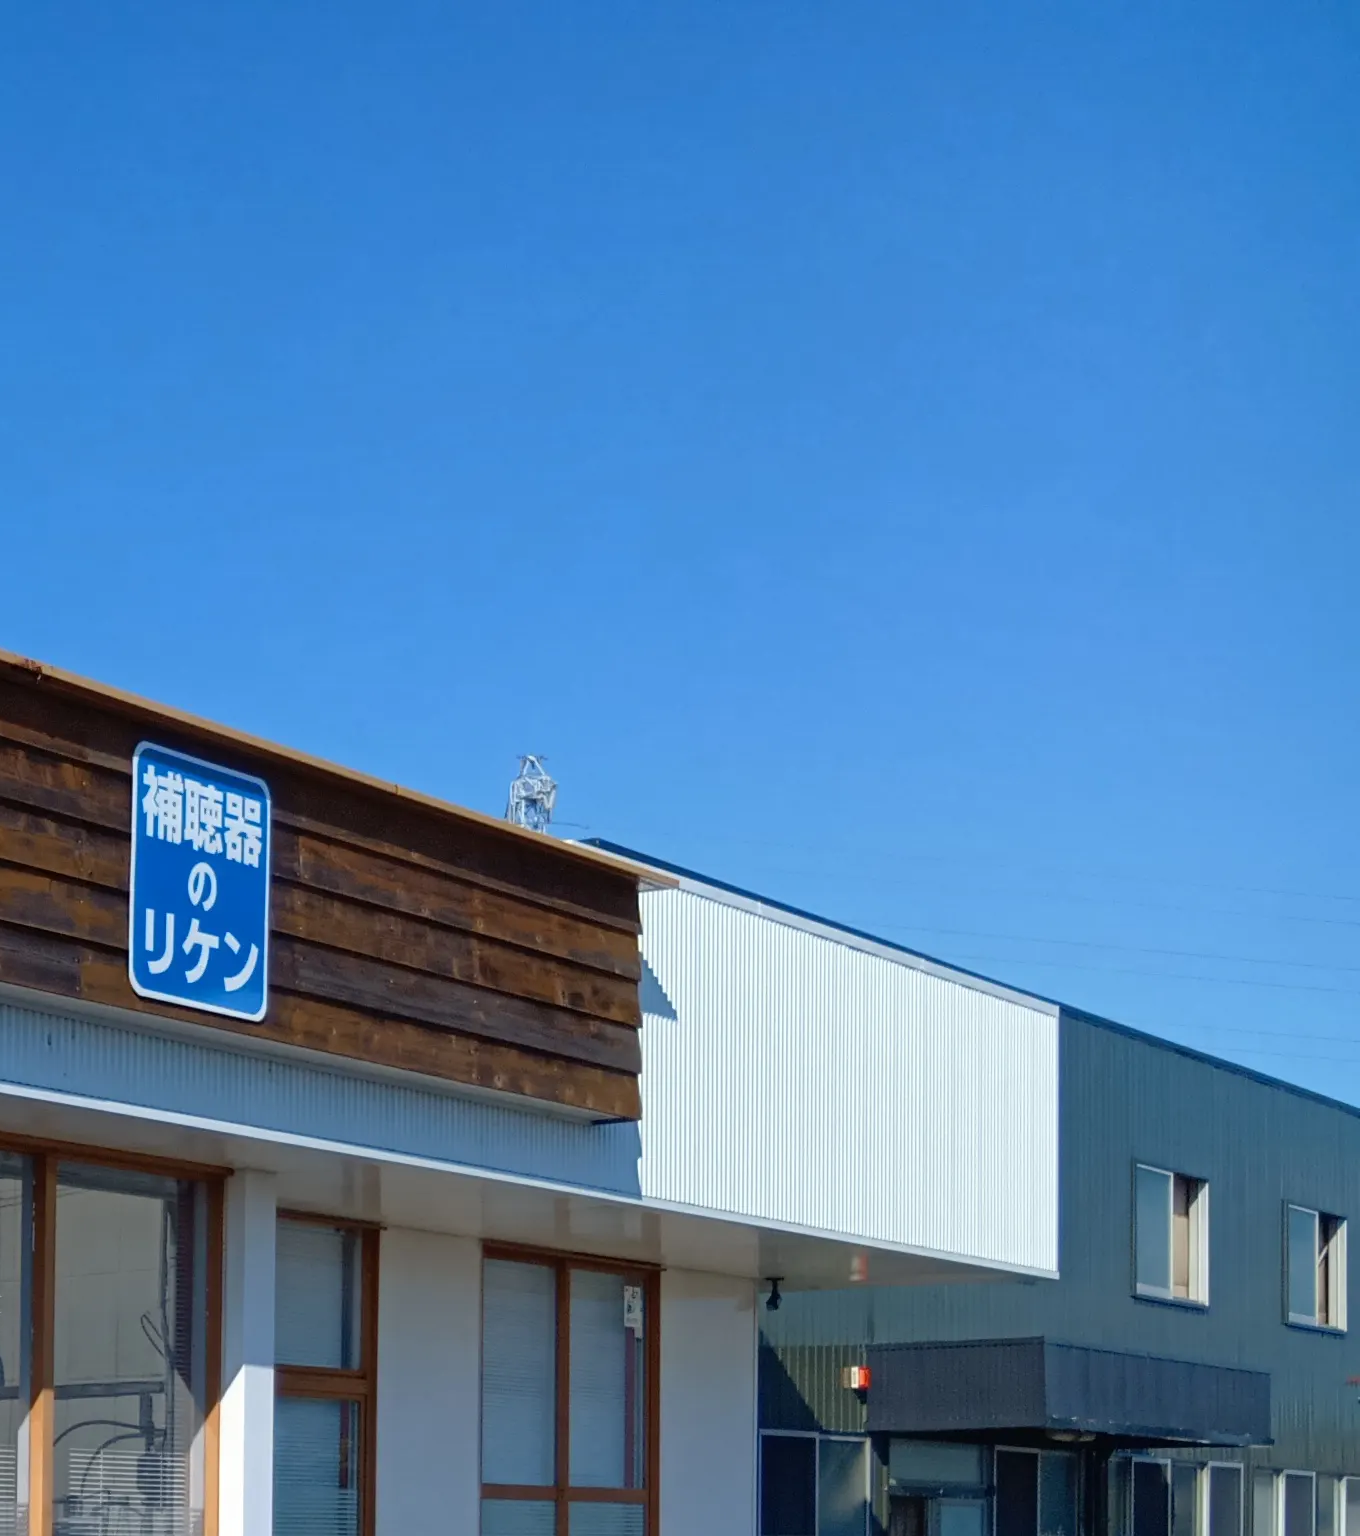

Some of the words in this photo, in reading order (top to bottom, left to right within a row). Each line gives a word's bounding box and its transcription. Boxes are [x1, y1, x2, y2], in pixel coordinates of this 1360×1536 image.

[142, 765, 262, 868] 補聴器
[187, 862, 217, 911] の
[145, 908, 258, 992] リケン
